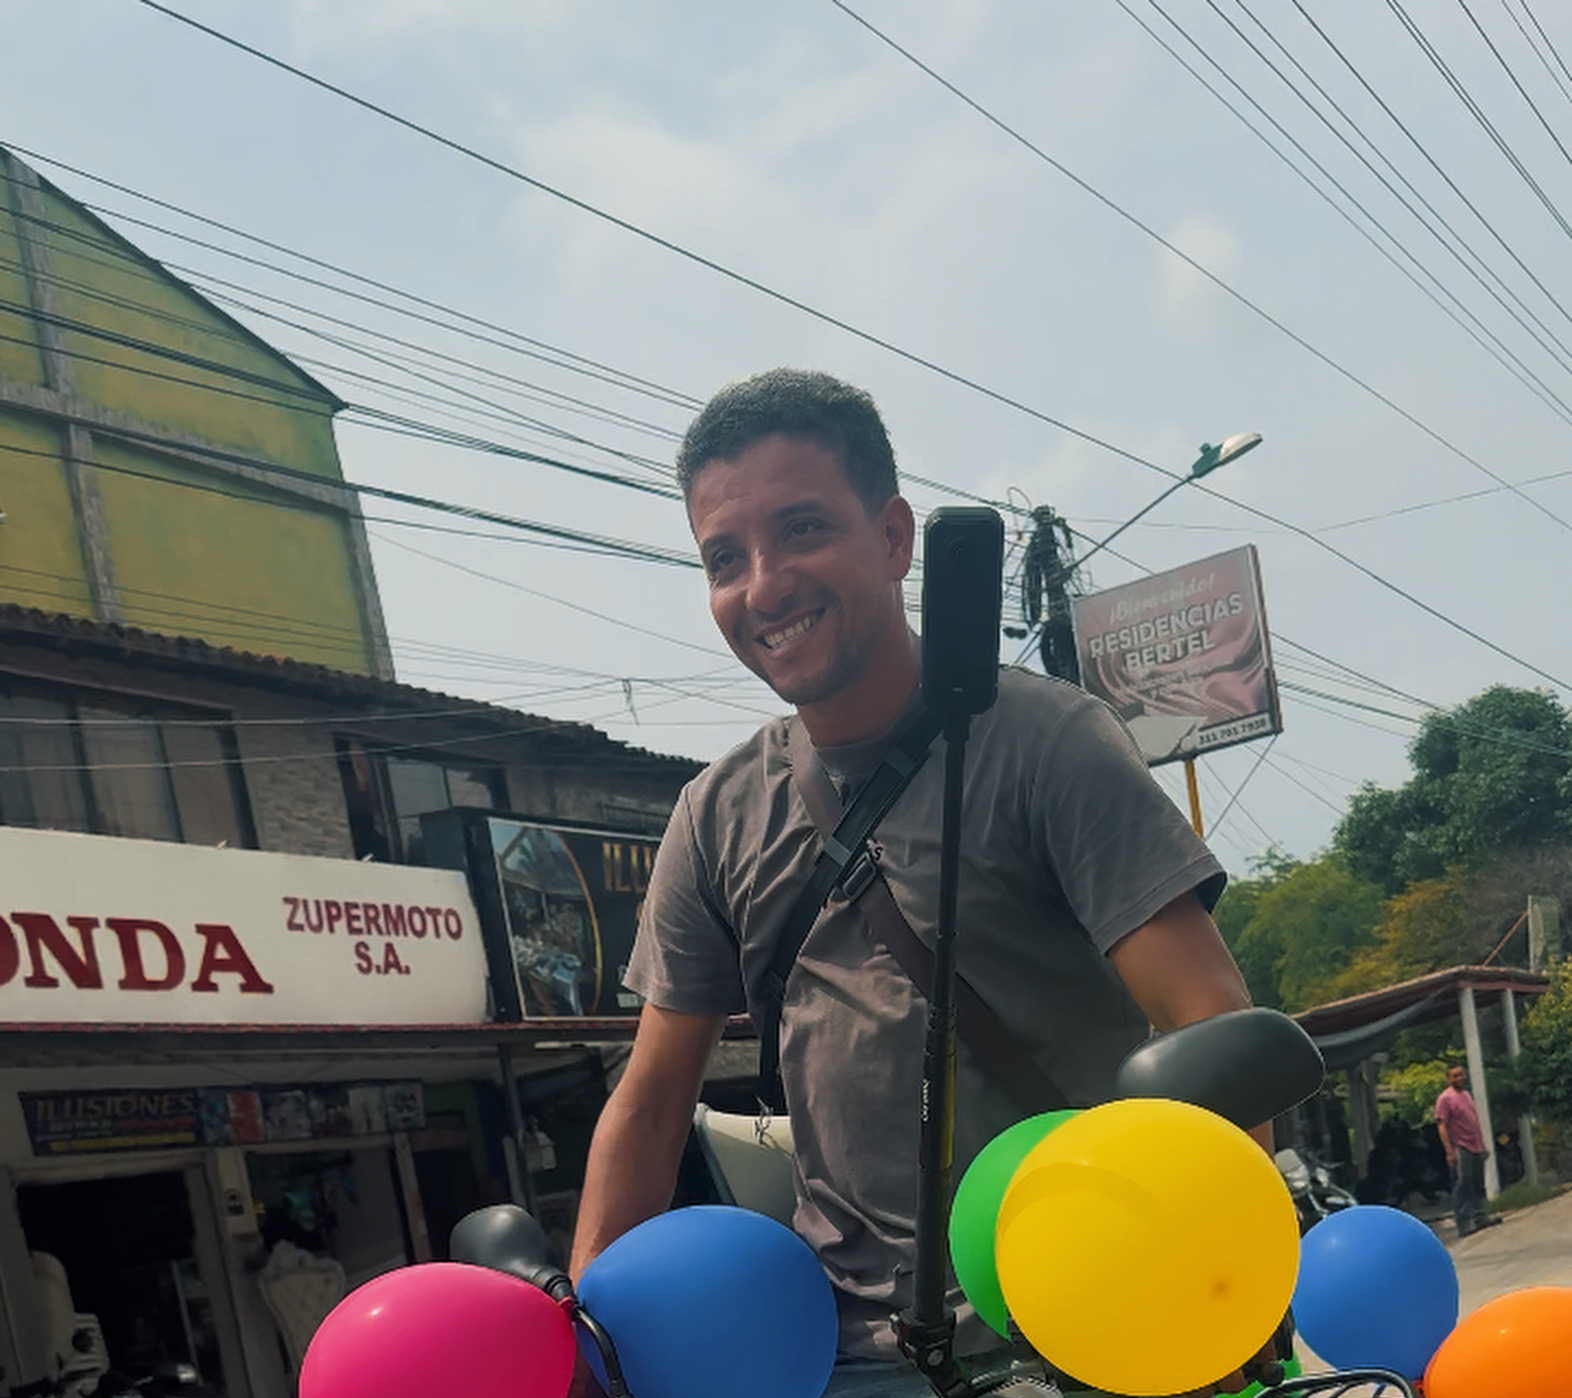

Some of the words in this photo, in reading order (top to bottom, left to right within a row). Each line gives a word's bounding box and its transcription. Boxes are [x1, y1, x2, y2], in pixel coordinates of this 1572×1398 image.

[1089, 593, 1243, 659] RESIDENCIAS
[1125, 631, 1217, 670] BERTEL
[282, 897, 463, 941] ZUPERMOTO
[0, 911, 274, 994] NDA
[354, 941, 411, 975] S.A.
